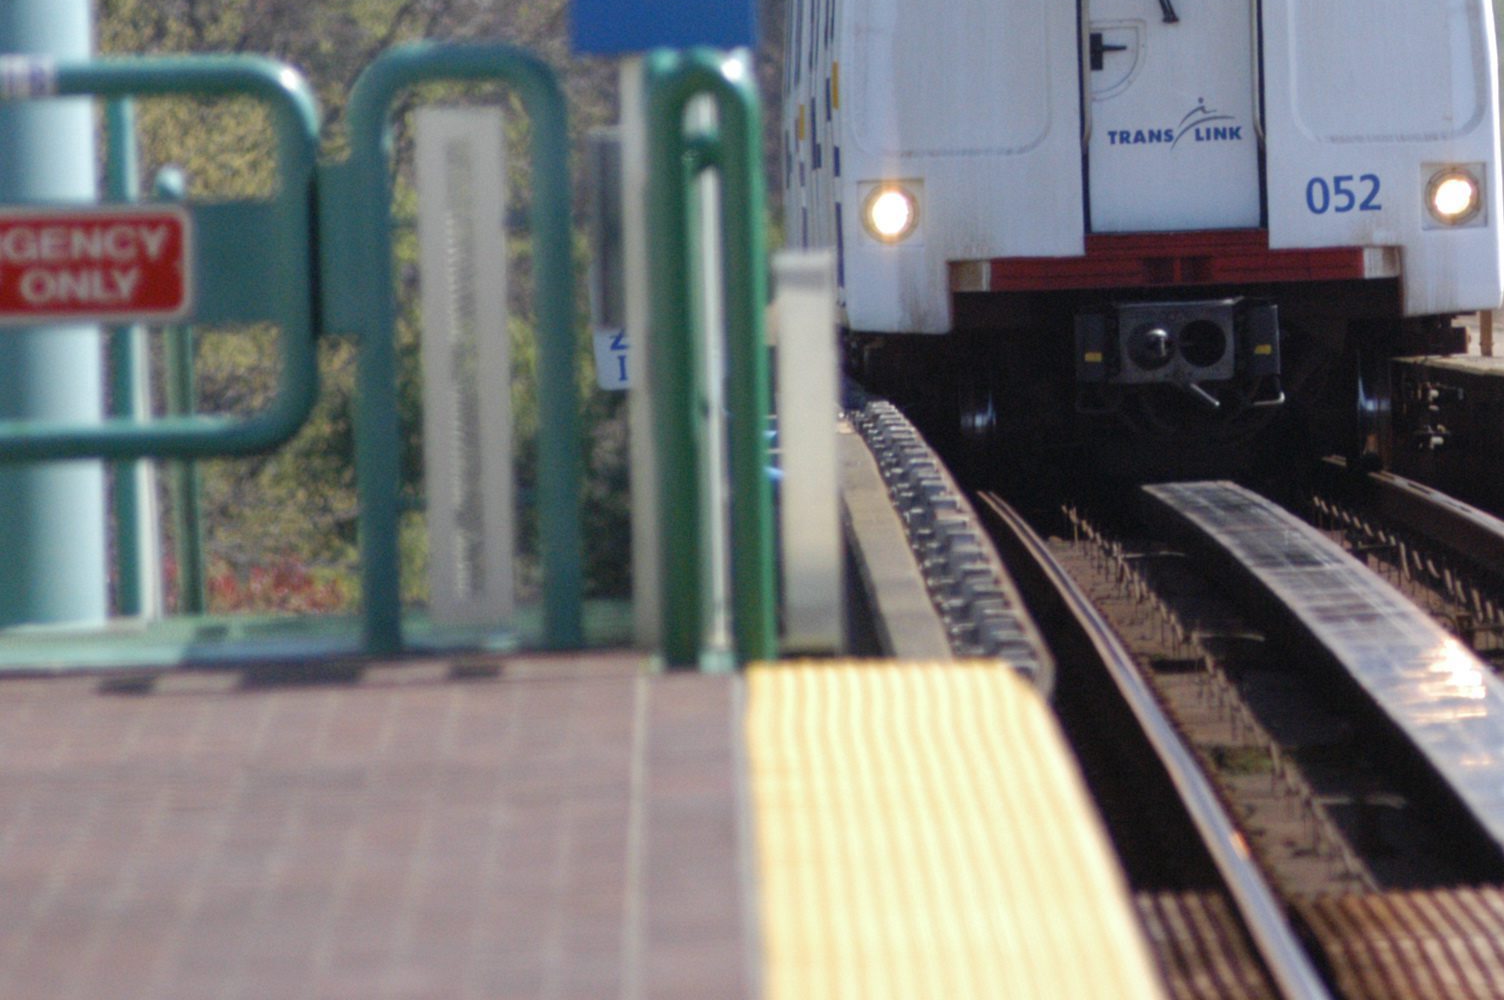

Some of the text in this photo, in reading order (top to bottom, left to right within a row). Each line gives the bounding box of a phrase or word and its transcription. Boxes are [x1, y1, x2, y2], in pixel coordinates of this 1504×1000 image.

[1107, 126, 1242, 145] TRANS LINK
[1305, 173, 1382, 215] 052
[0, 225, 168, 263] GENCY
[20, 266, 139, 303] ONLY
